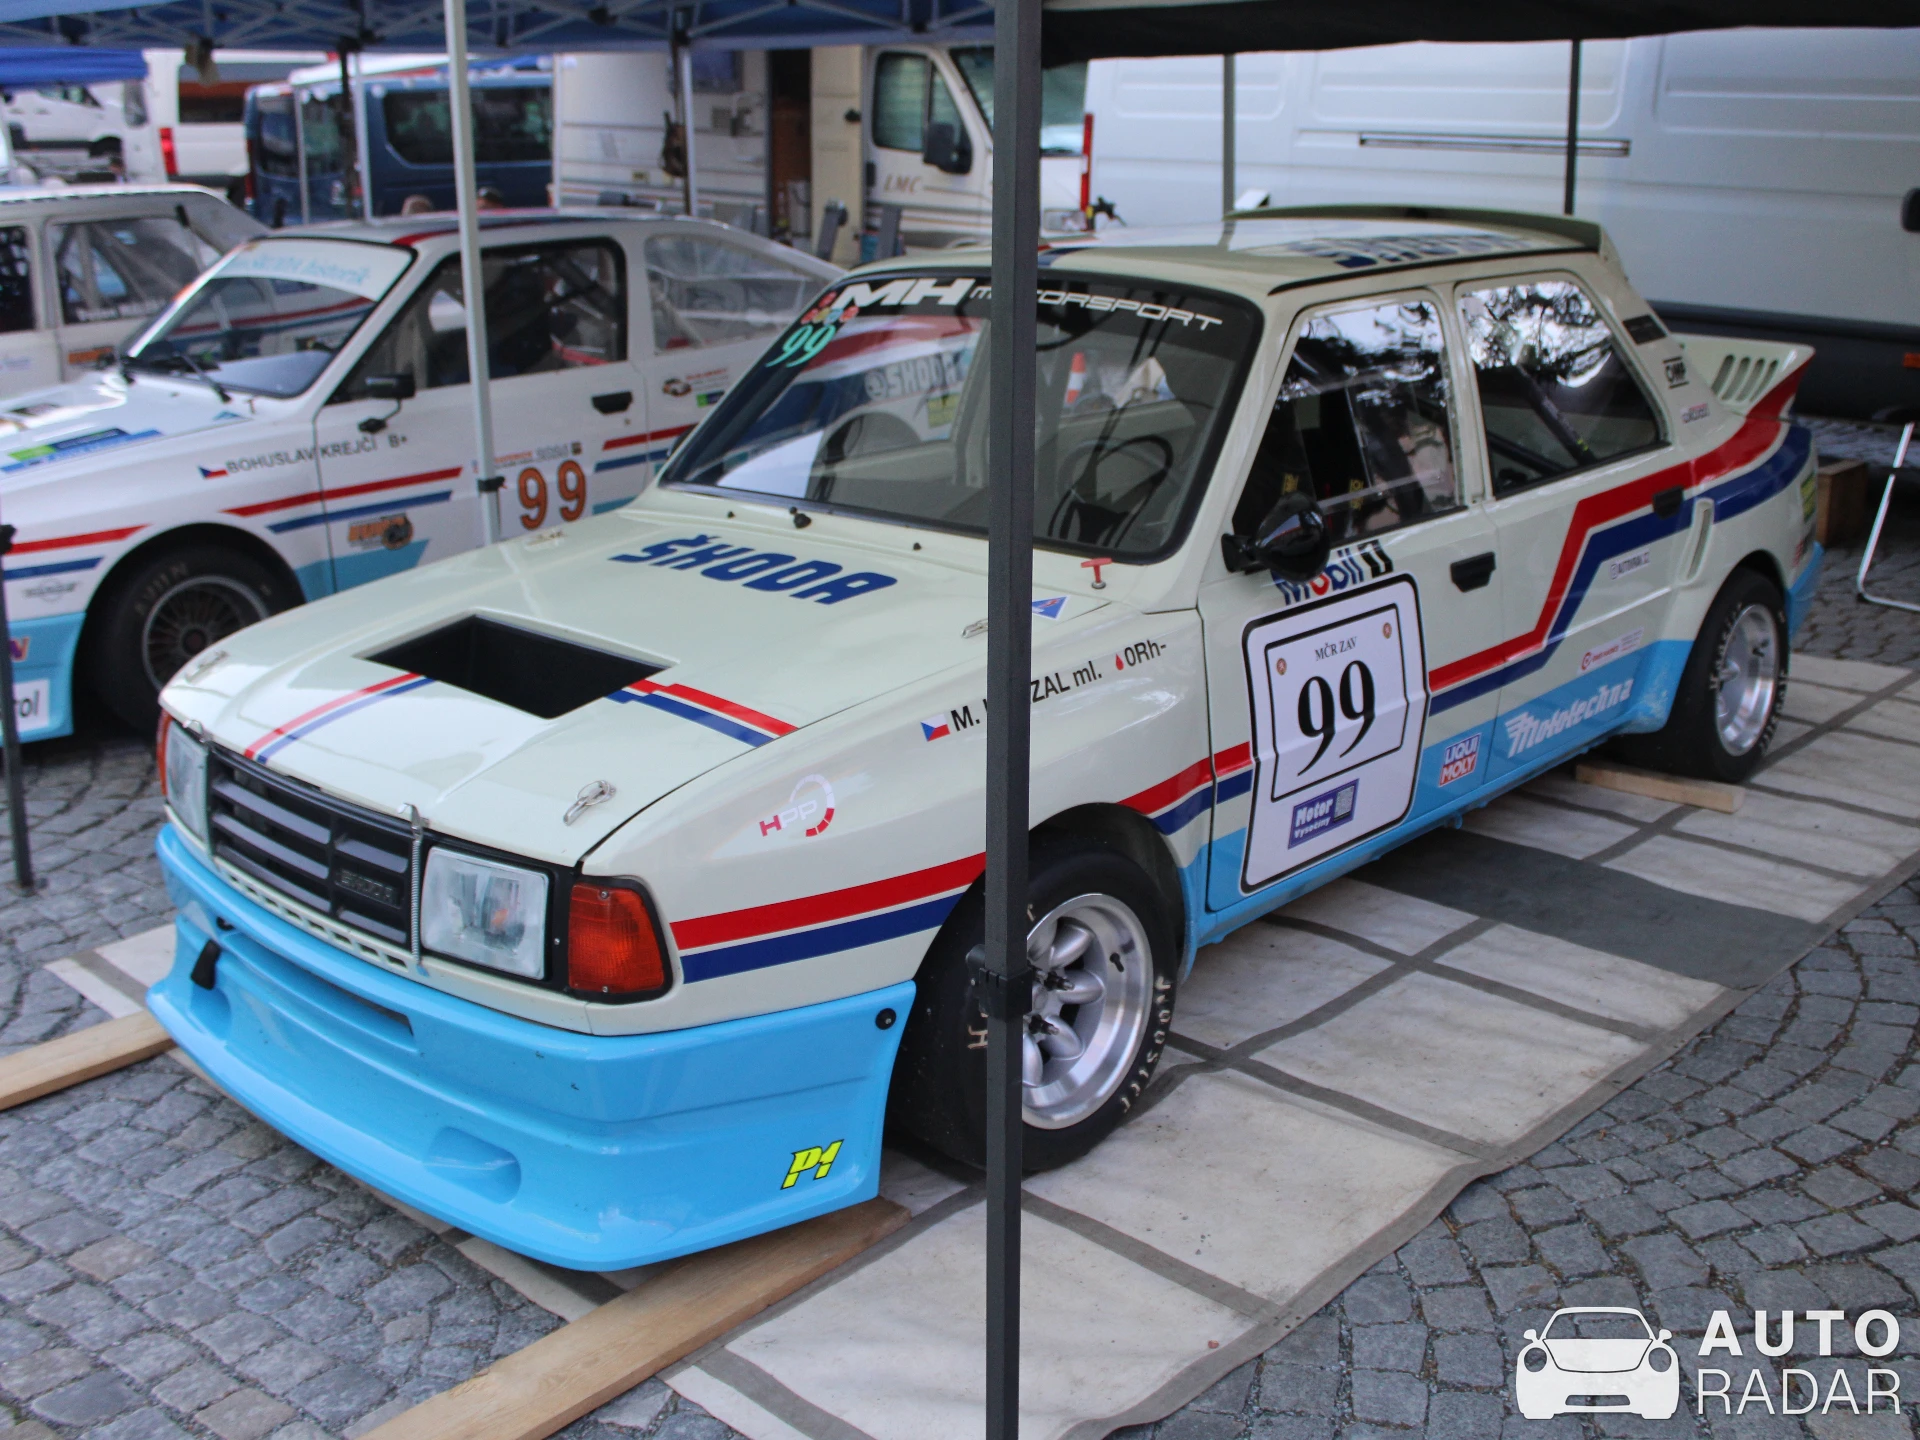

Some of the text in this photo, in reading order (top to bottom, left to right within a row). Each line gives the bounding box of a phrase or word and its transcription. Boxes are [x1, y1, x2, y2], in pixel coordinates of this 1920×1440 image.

[831, 277, 976, 309] MH
[766, 324, 837, 368] 99
[226, 446, 317, 473] BOHUSLAV
[320, 436, 378, 459] KREJČÍ
[518, 459, 587, 530] 99
[608, 533, 899, 606] ŠKODA
[1314, 636, 1358, 662] MČR ZAV
[951, 705, 981, 732] M.
[1073, 660, 1103, 688] ml.
[1297, 660, 1376, 776] 99
[1505, 678, 1635, 759] Mototechna
[1442, 754, 1476, 784] MOLY
[1445, 736, 1479, 763] LIQUI
[1296, 799, 1334, 828] Motor
